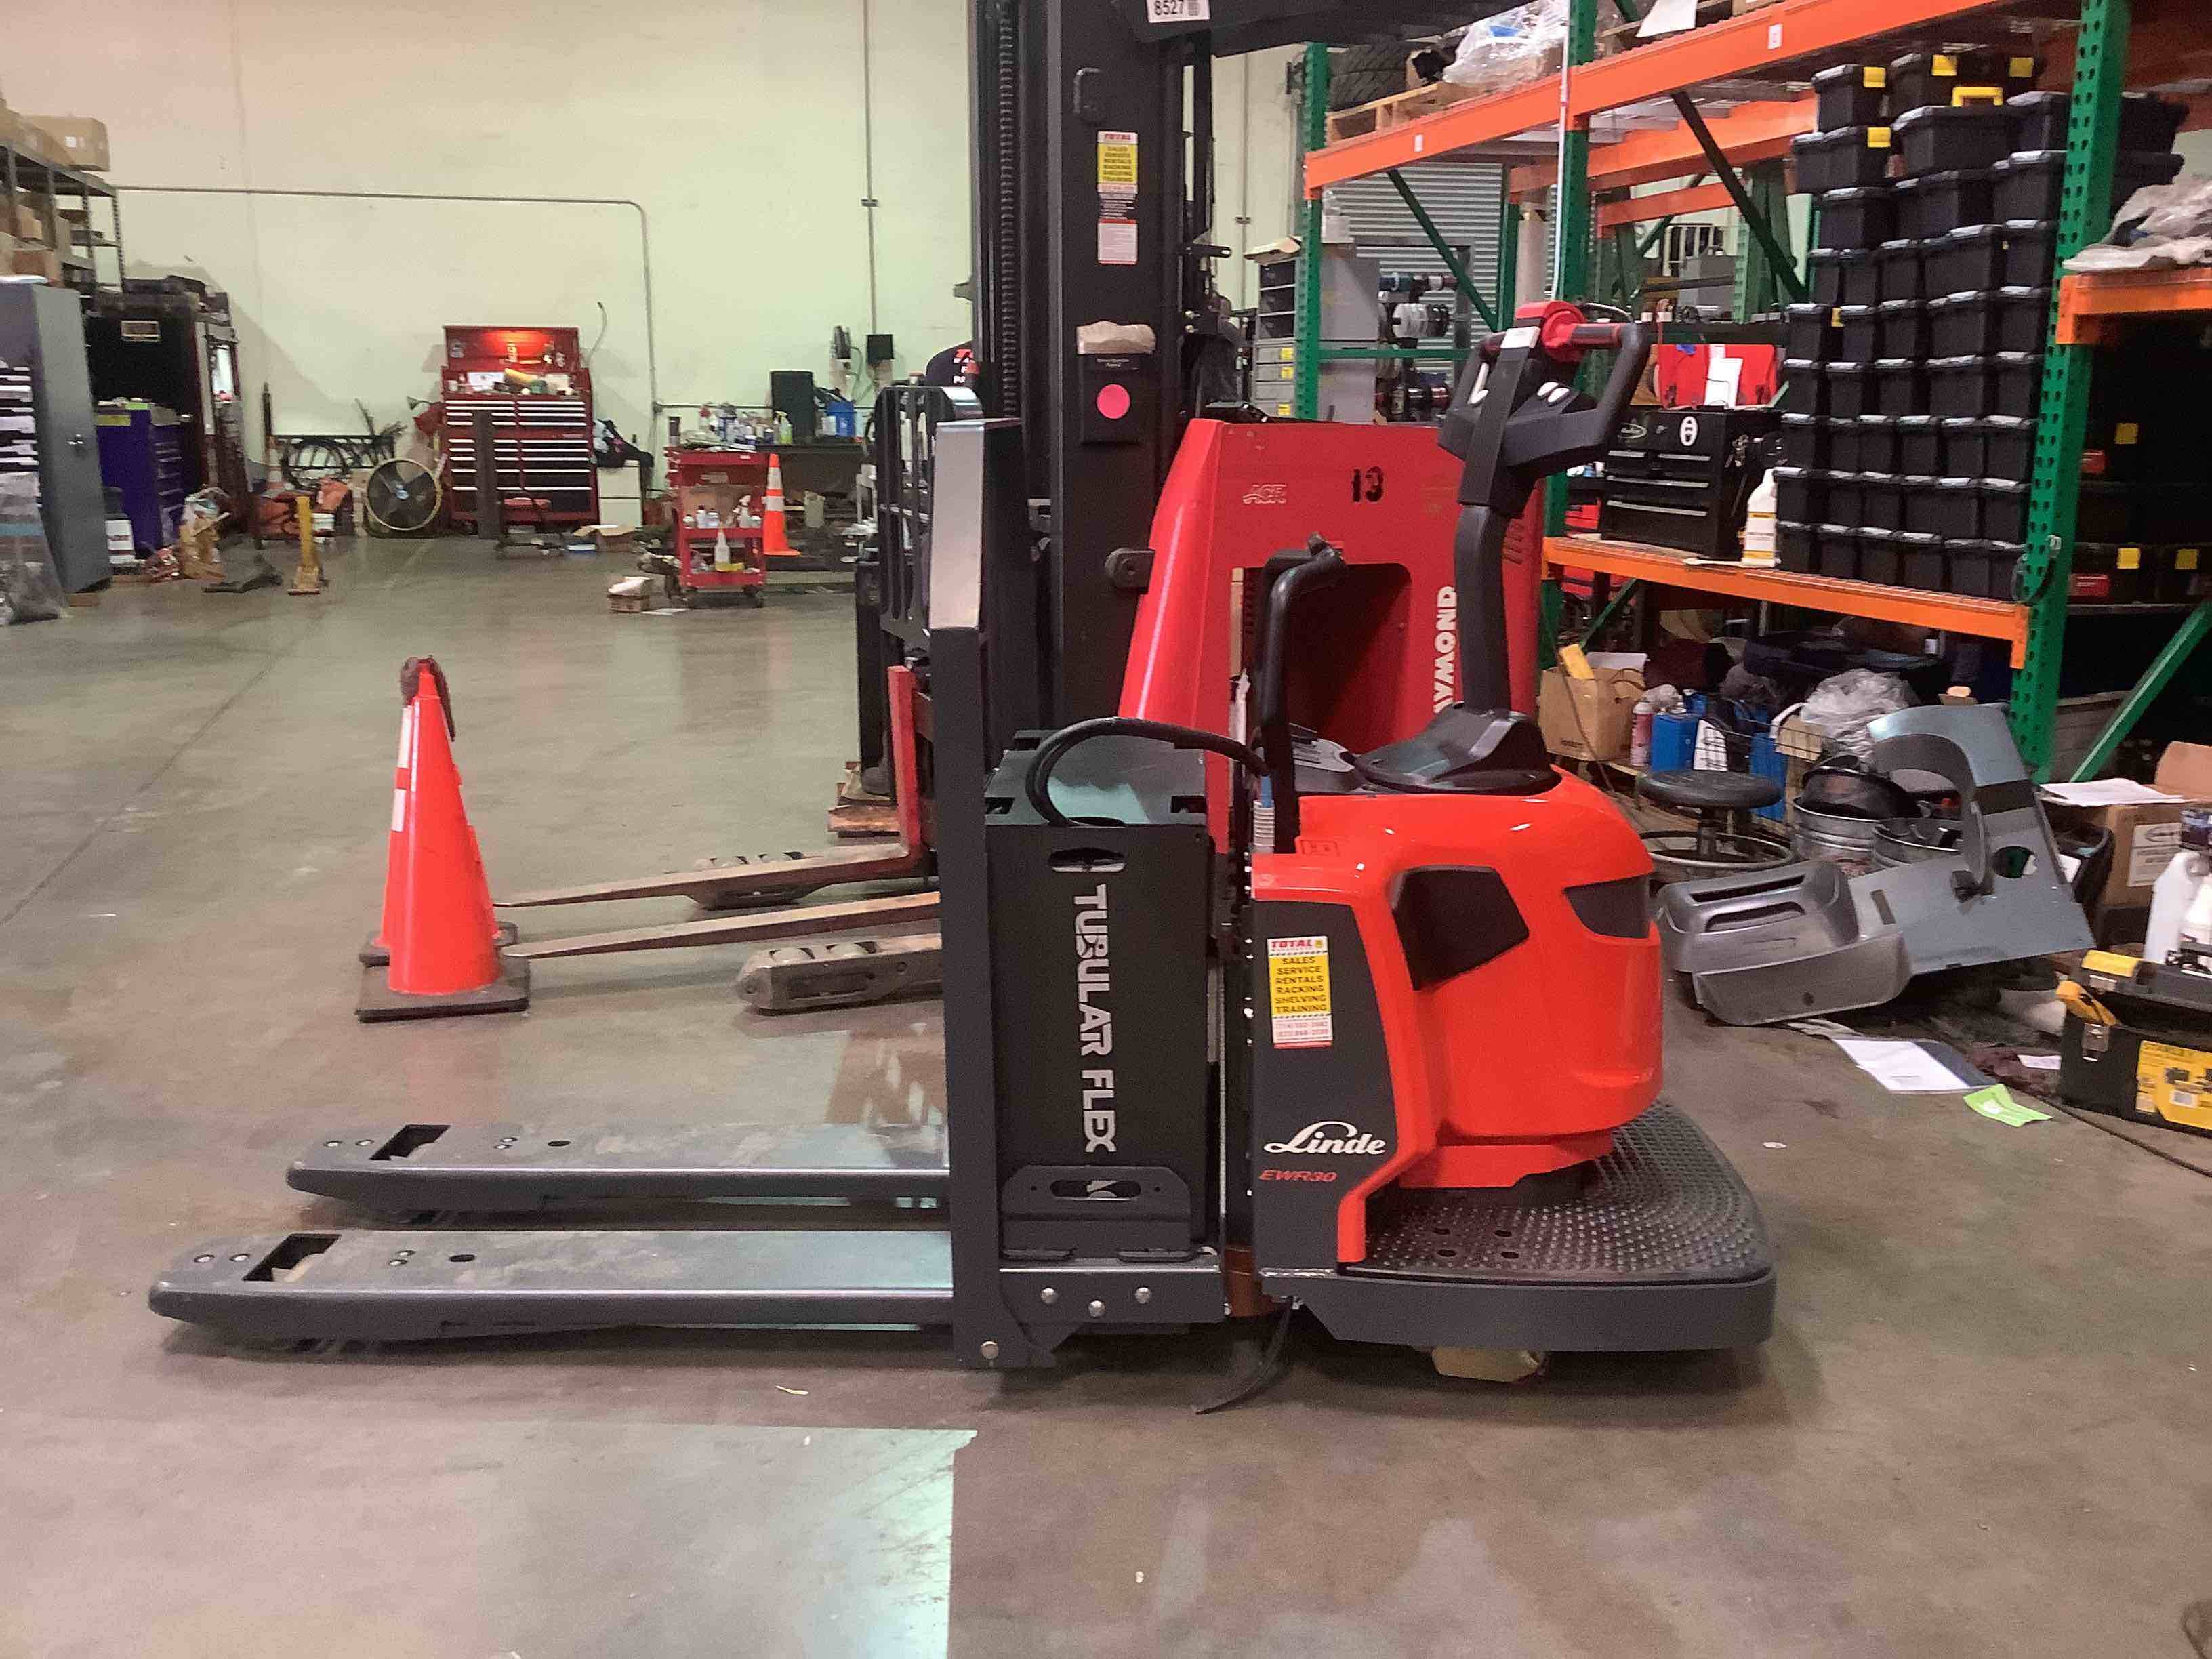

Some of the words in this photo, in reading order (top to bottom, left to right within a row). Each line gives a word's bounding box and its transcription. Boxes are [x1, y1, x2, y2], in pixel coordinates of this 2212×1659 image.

[1352, 466, 1384, 503] 13
[1433, 586, 1457, 714] YMOND
[1271, 939, 1312, 948] TOTAL
[1282, 956, 1315, 964] SALES
[1073, 883, 1113, 1057] TUBULAR
[1276, 966, 1322, 975] SERVICE
[1275, 976, 1324, 984] RENTALS
[1275, 985, 1324, 994] RACKING
[1275, 994, 1327, 1004] SHELVING
[1275, 1004, 1327, 1013] TRAINING
[1082, 1069, 1118, 1153] FLEX
[1263, 1120, 1387, 1155] Linde
